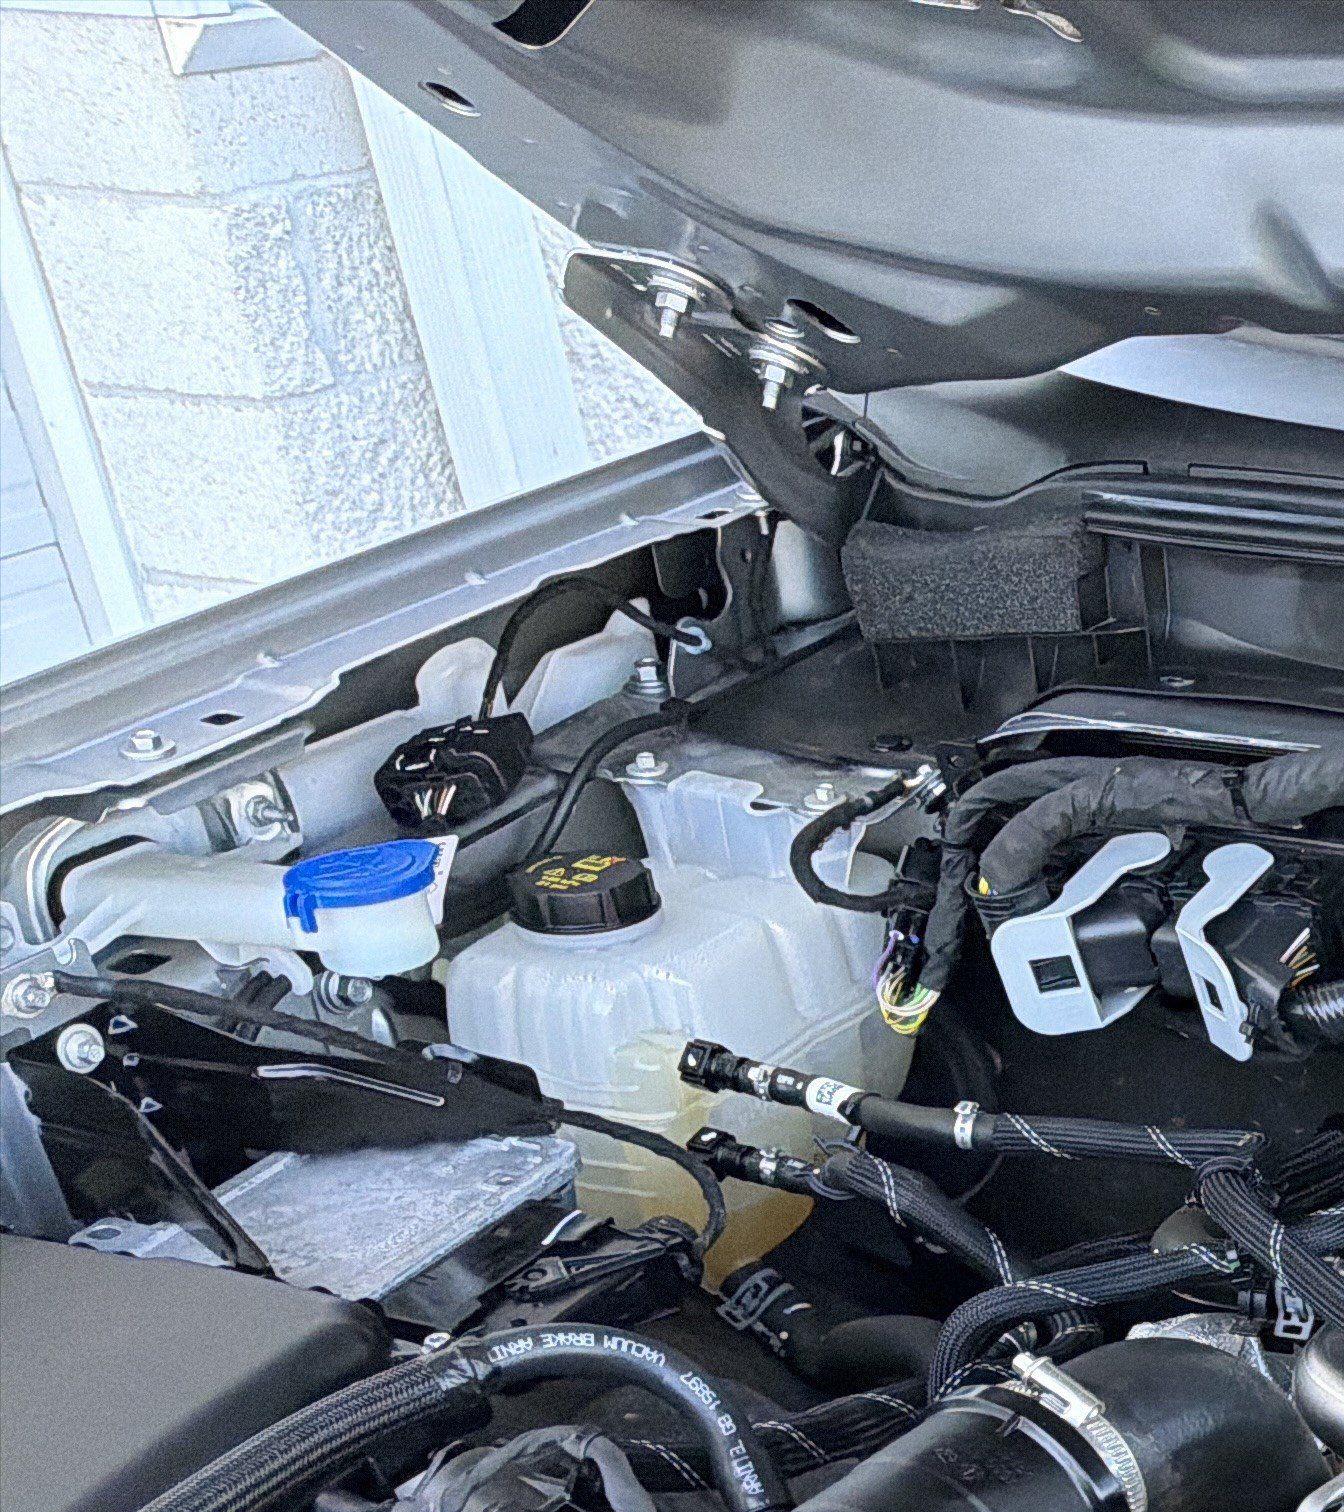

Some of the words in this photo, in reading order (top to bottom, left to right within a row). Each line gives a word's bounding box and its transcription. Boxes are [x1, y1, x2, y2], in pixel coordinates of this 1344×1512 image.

[539, 1332, 595, 1352] BRAKE
[601, 1334, 666, 1367] VACUUM
[713, 1413, 737, 1437] GB
